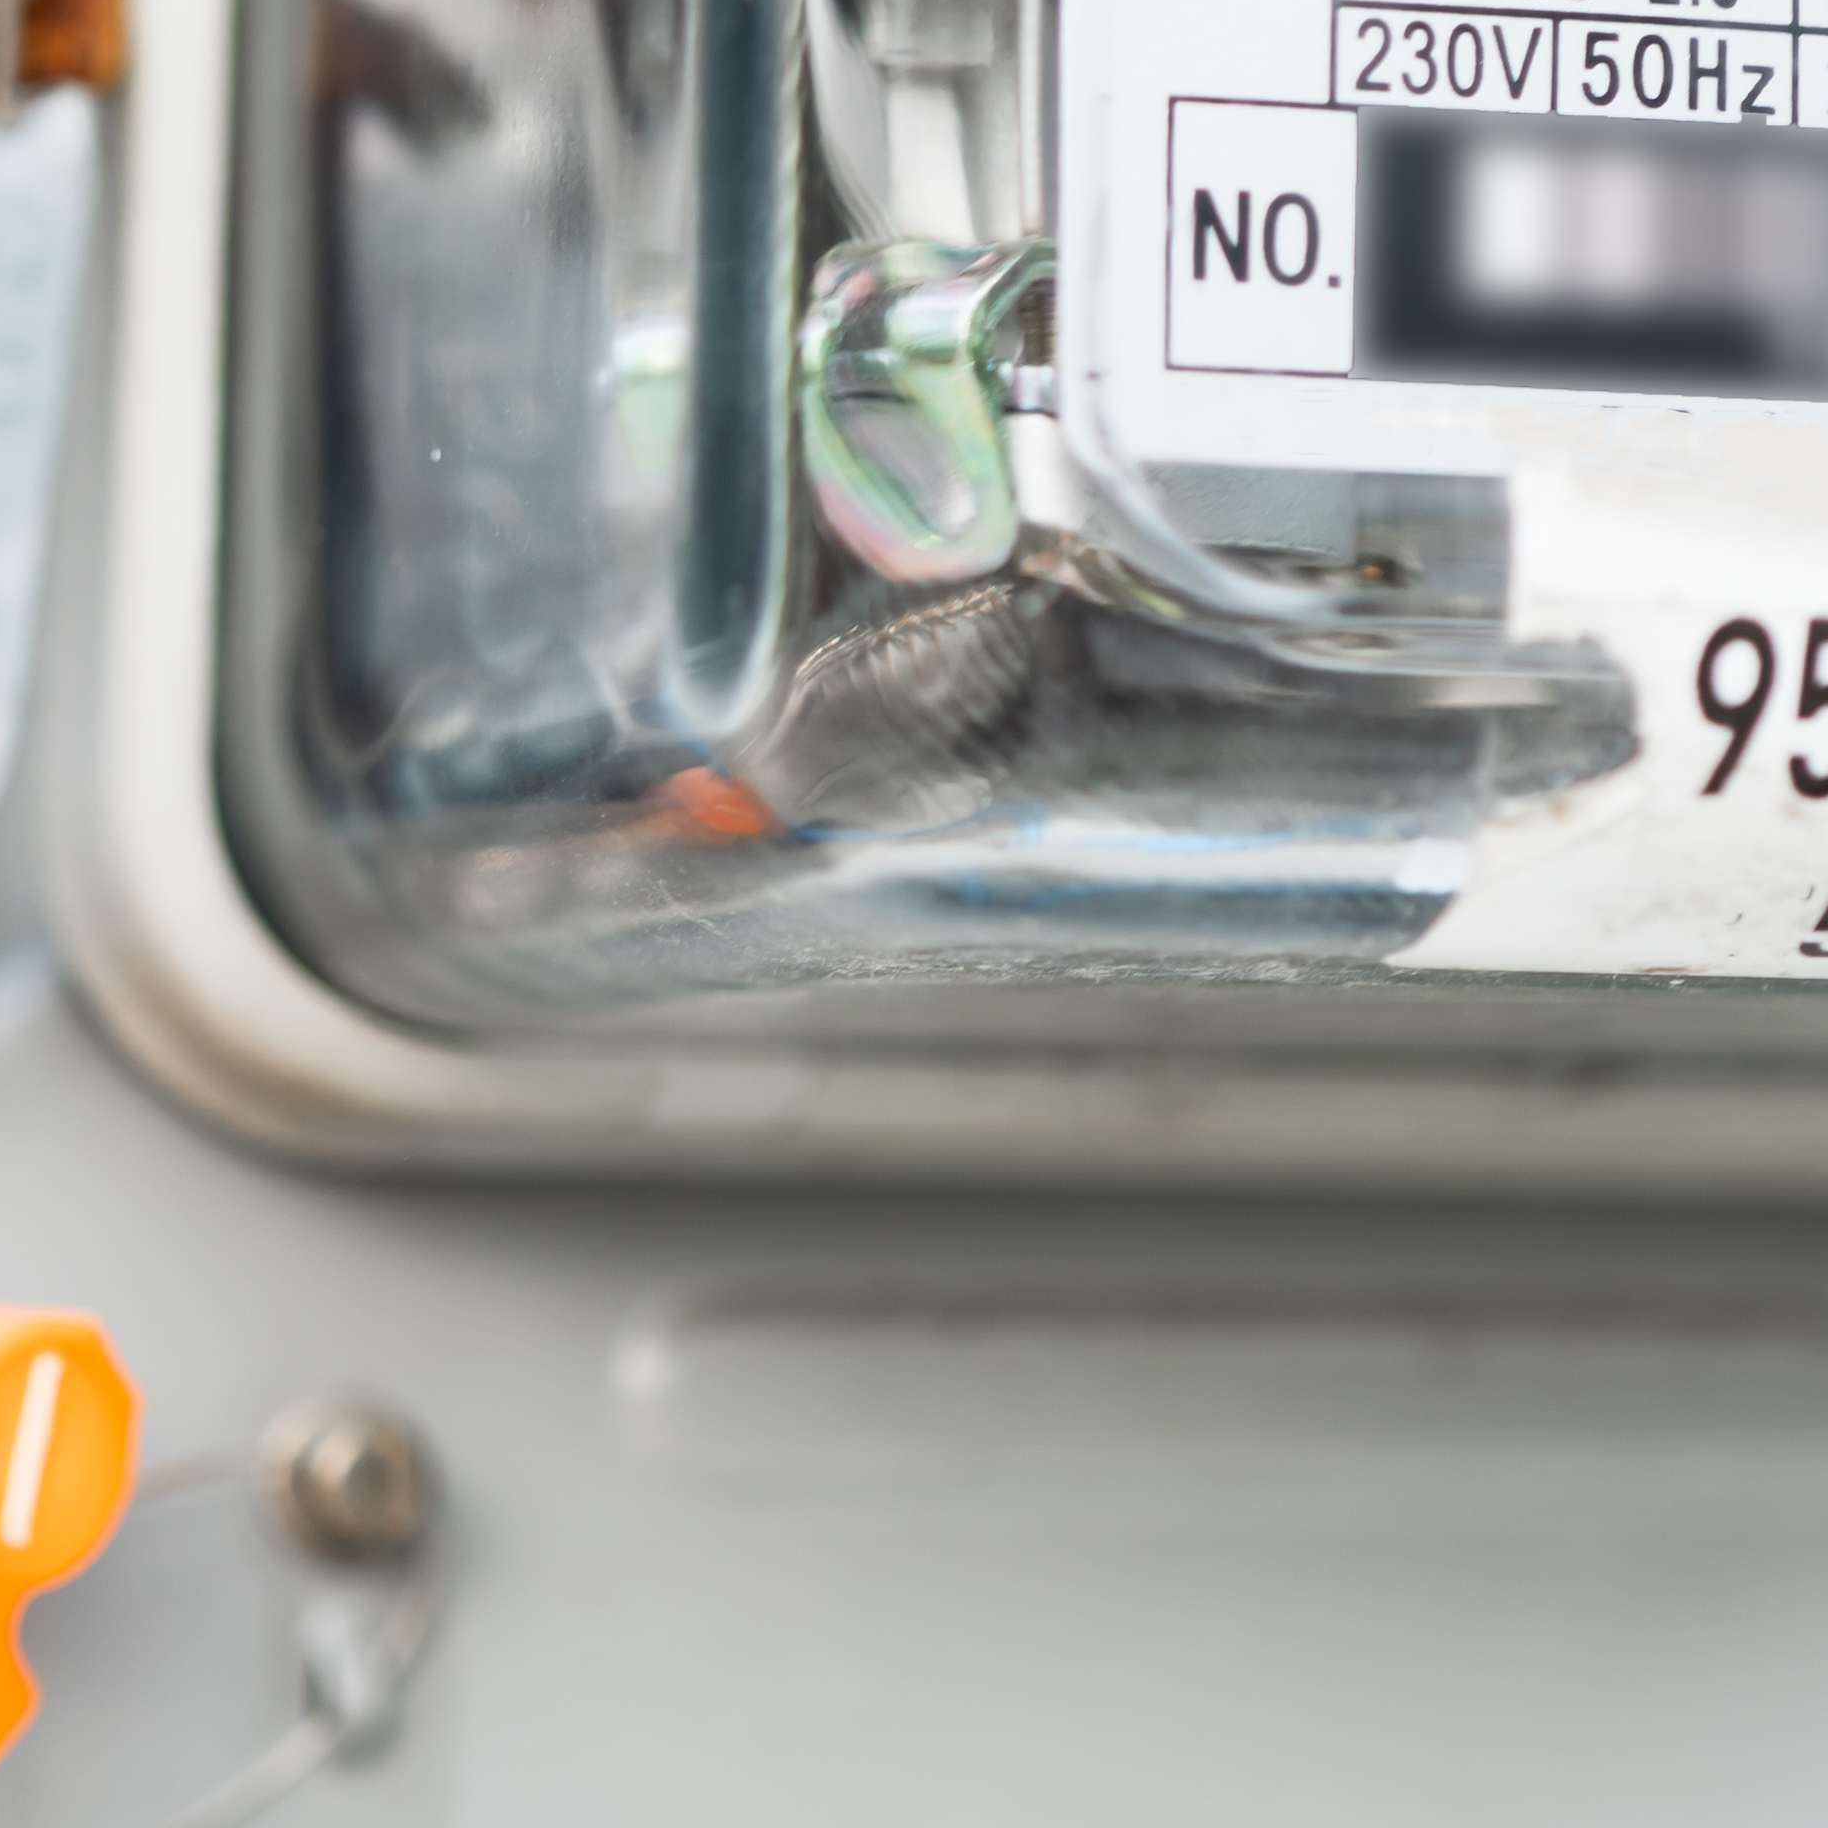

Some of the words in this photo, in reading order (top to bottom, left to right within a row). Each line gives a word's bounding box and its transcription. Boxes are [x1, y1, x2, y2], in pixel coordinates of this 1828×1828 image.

[1354, 18, 1543, 100] 230V
[1581, 31, 1778, 116] 50Hz
[1192, 187, 1342, 289] NO.
